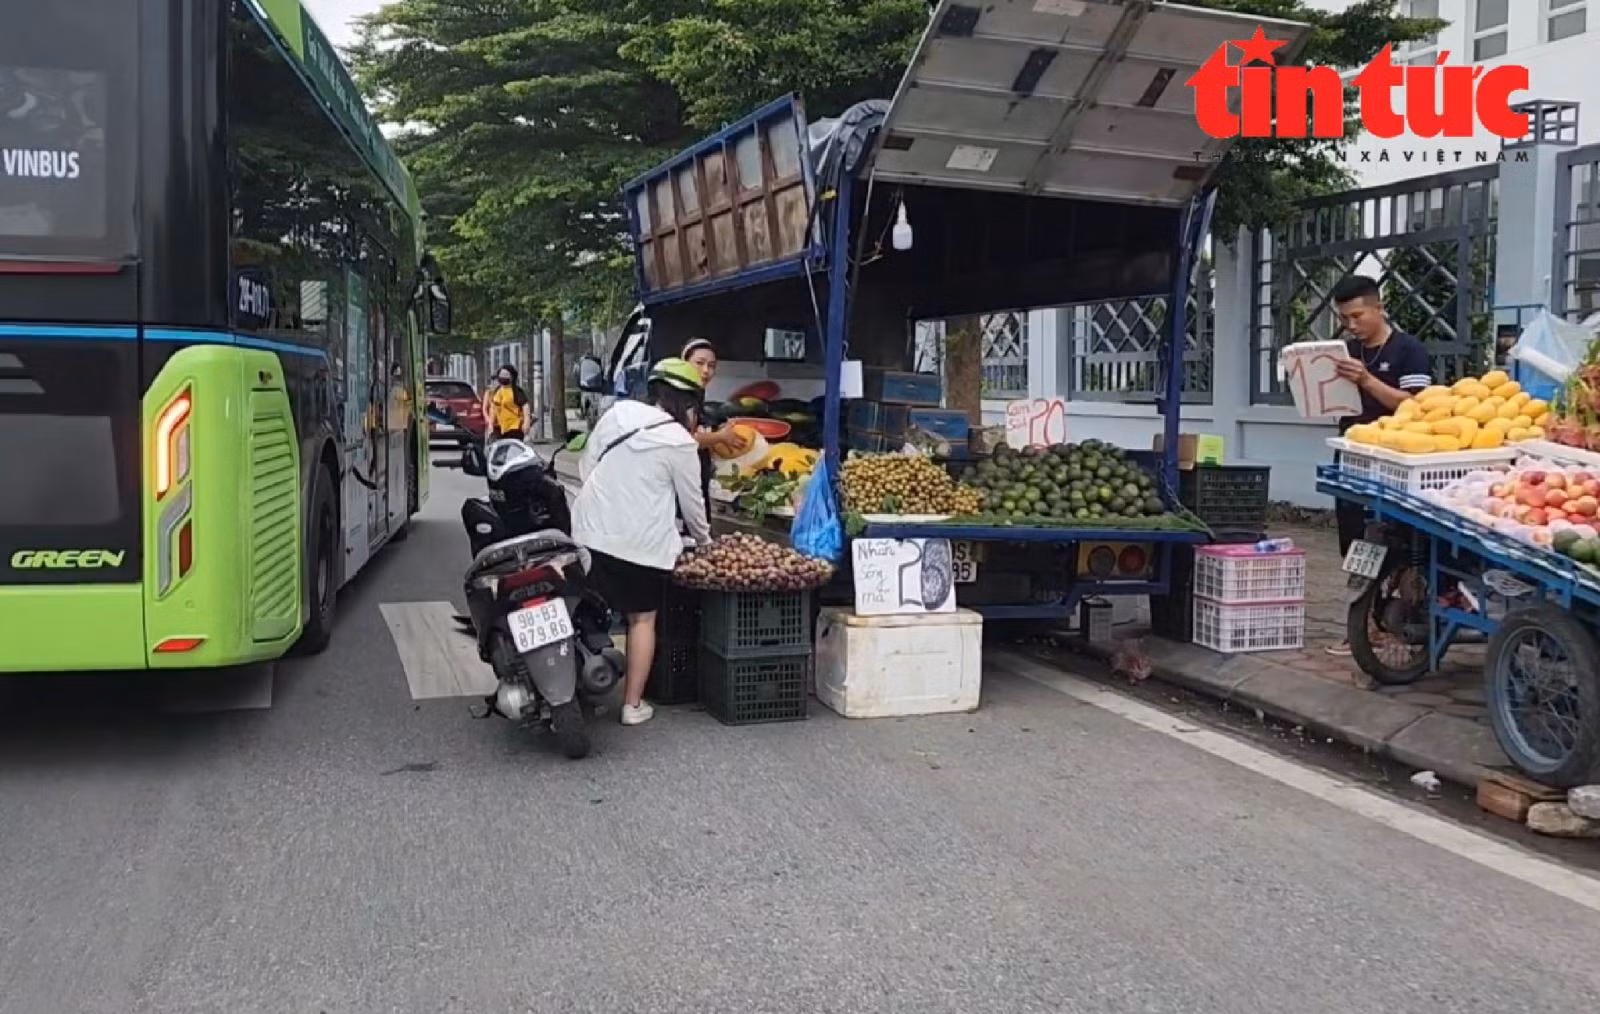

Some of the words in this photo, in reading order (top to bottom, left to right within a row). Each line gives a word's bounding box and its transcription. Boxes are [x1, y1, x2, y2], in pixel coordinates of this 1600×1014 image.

[3, 148, 80, 178] VINBUS
[11, 550, 125, 568] GREEN
[857, 540, 896, 560] Nhãn
[517, 604, 558, 629] 98-B3
[518, 618, 568, 648] 879.86
